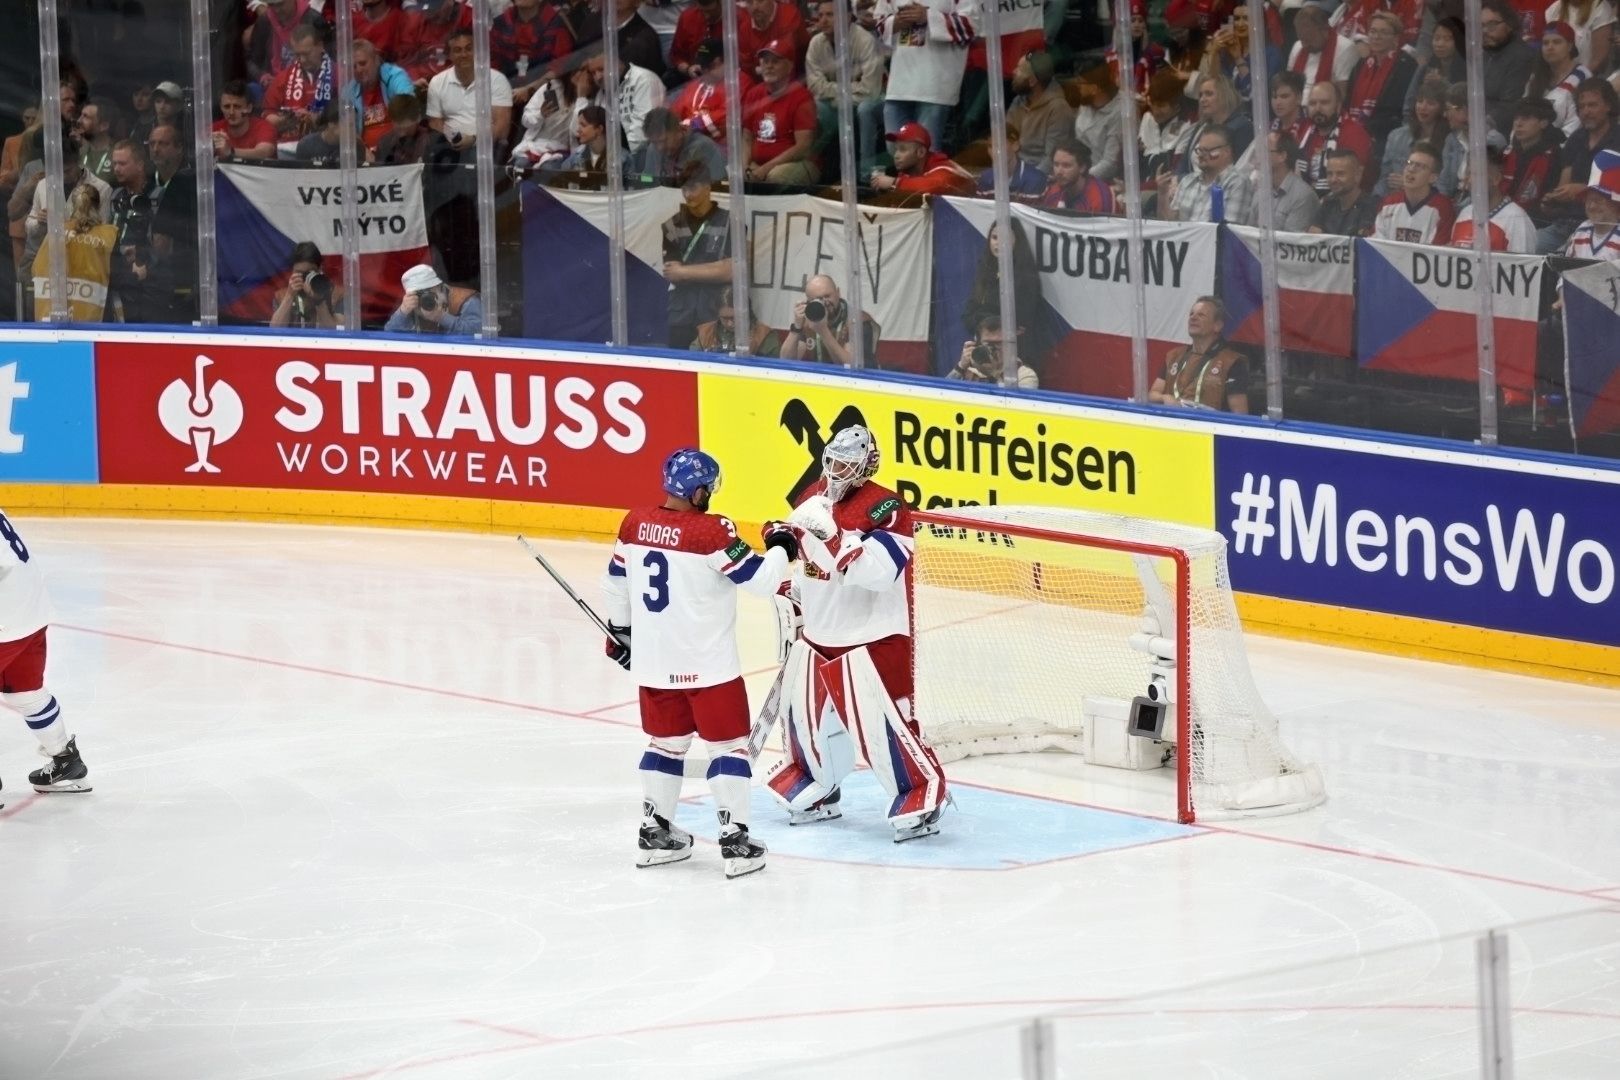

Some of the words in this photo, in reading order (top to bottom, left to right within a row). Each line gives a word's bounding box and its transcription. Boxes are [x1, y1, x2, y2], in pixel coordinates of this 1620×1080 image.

[297, 179, 404, 206] VYSOKÉ
[1035, 226, 1189, 288] DUBANY
[1412, 252, 1539, 298] DUBNY
[42, 281, 93, 298] POTO
[274, 361, 647, 454] STRAUSS
[276, 442, 547, 488] WORKWEAR
[895, 411, 1136, 495] Raiffeisen
[637, 522, 682, 547] GUDAS
[720, 518, 737, 538] 3
[1231, 472, 1615, 604] #MensWo
[642, 550, 670, 613] 3
